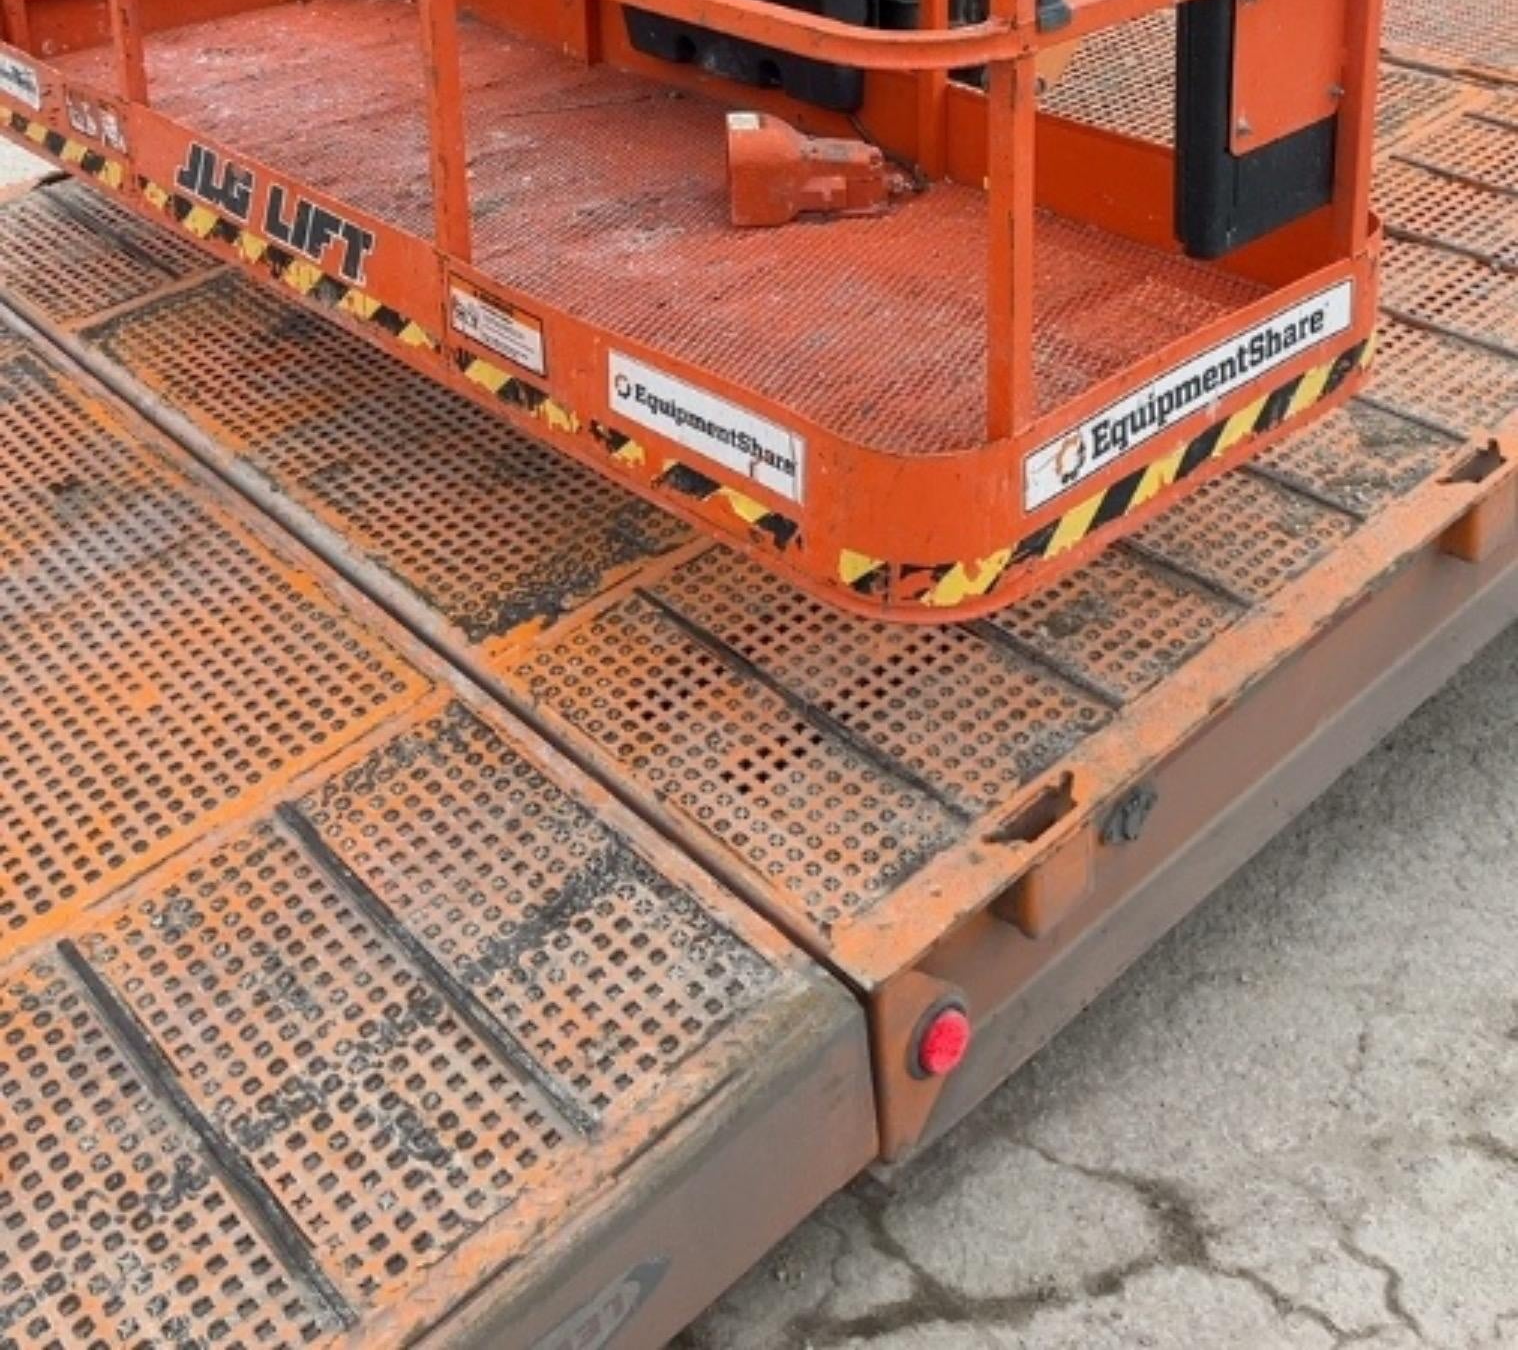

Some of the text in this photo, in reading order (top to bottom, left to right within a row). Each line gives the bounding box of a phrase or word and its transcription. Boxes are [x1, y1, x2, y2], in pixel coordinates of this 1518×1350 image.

[174, 141, 375, 286] JLG LIFT
[634, 382, 797, 478] EquipmentShare
[1089, 307, 1325, 461] EquipmentShare
